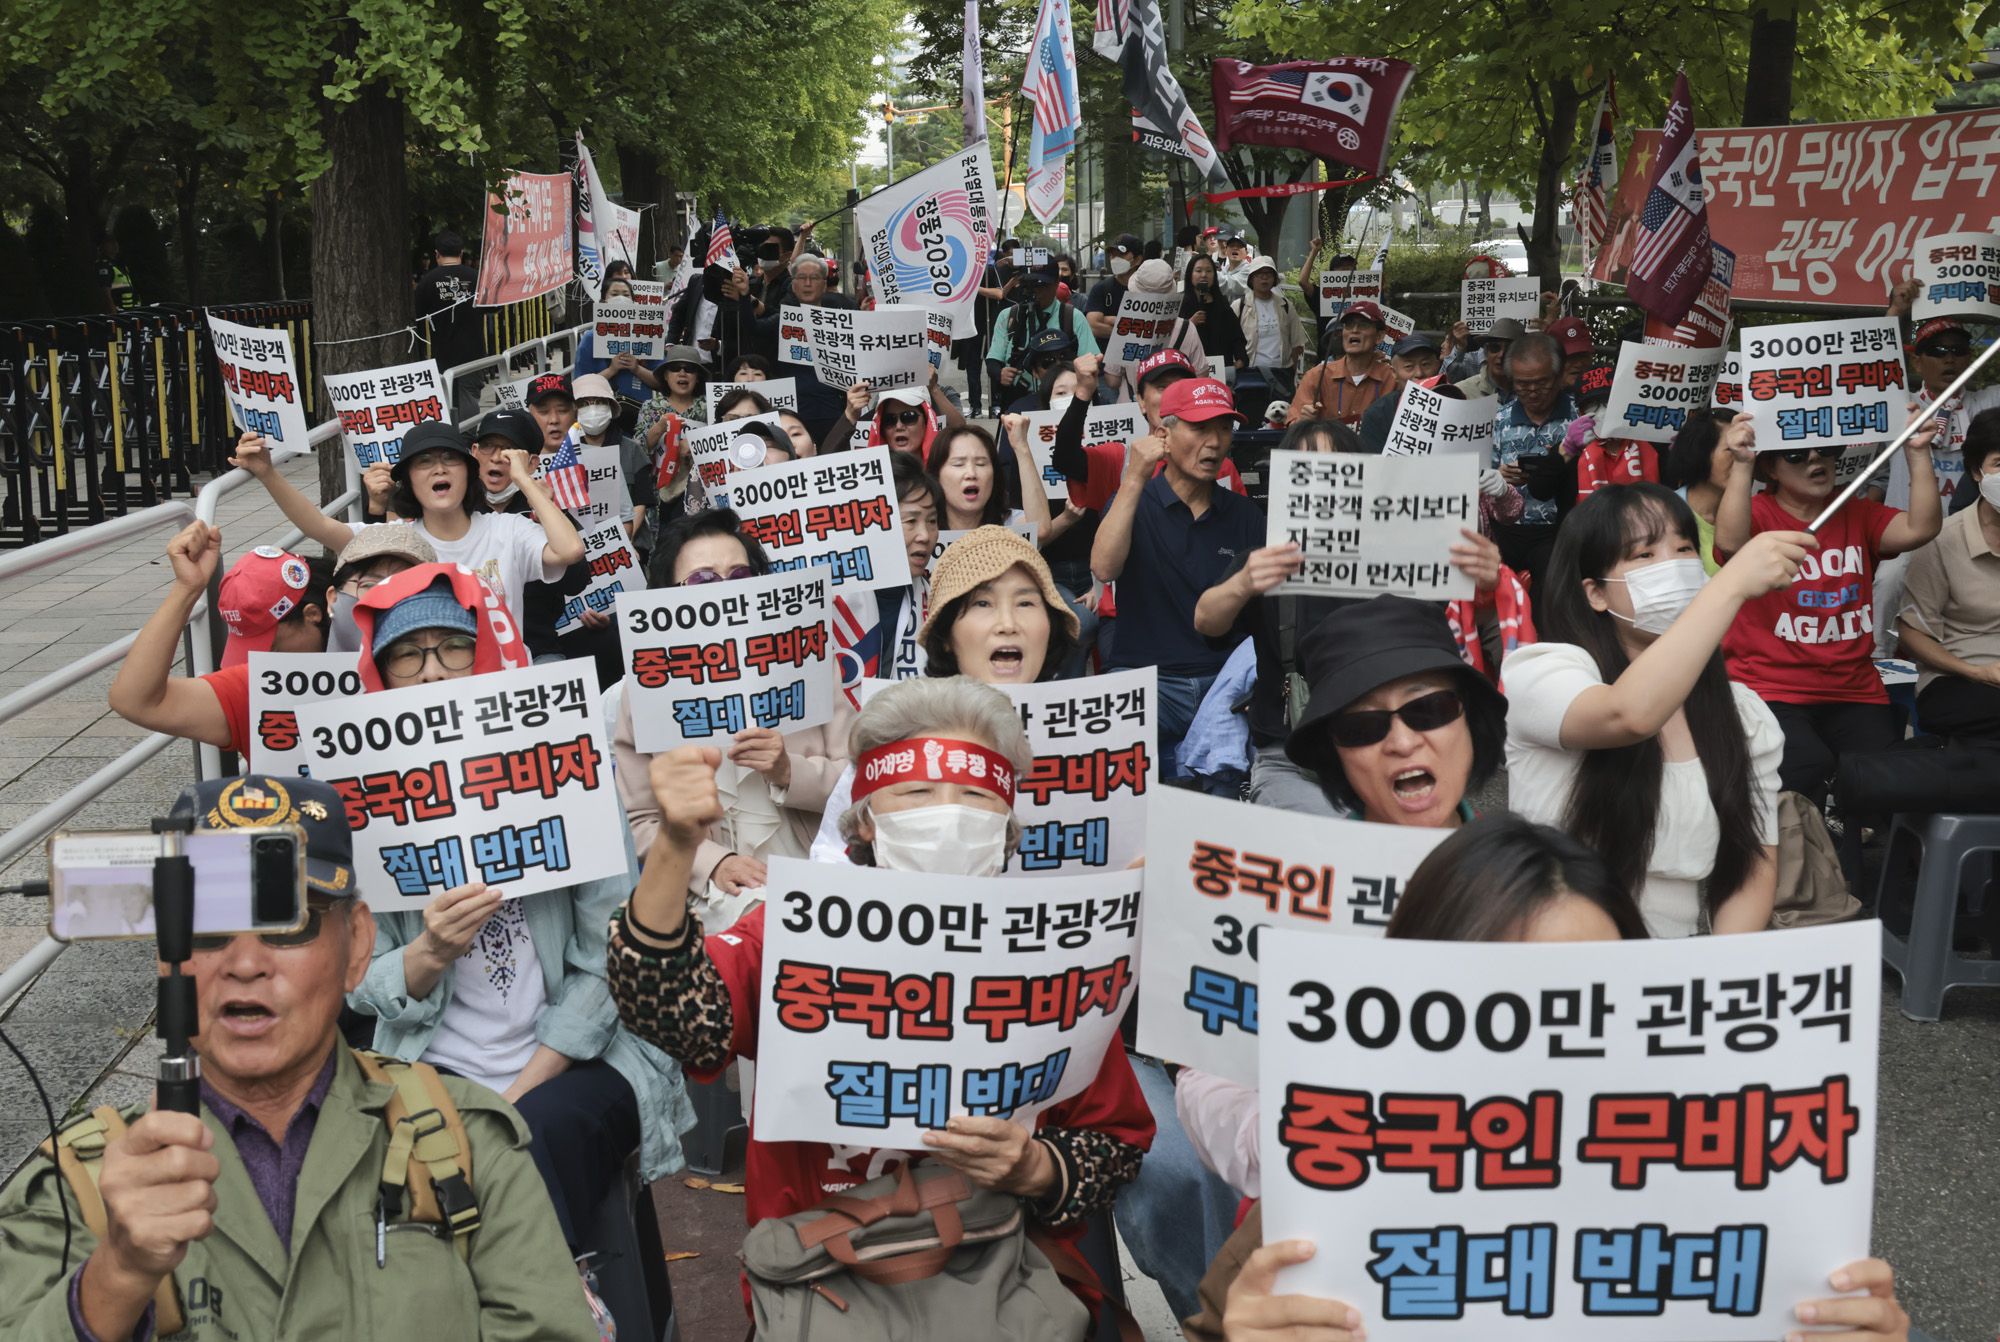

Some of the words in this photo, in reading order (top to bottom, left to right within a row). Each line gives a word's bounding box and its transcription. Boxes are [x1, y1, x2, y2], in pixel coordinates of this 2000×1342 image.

[1699, 131, 1788, 207] 중국인
[1787, 122, 1912, 208] 무비자
[916, 197, 952, 297] 장풍2030
[1765, 217, 1859, 297] 관광
[1928, 244, 1978, 265] 중국인
[632, 284, 651, 293] 000만
[1357, 274, 1380, 284] 관광객
[1467, 280, 1496, 292] 중국인
[1927, 281, 1988, 305] 무비자
[1123, 299, 1164, 315] 3000만
[1466, 292, 1496, 305] 관광객
[1497, 291, 1539, 304] 유치보다
[1466, 305, 1496, 317] 자국민
[596, 308, 637, 320] 3000만
[638, 309, 664, 321] 관광객
[809, 308, 853, 330] 중국인
[1116, 317, 1156, 339] 중국인
[1687, 310, 1723, 338] VISA-FREE
[595, 322, 631, 338] 중국인
[631, 323, 664, 339] 무비자
[812, 328, 856, 351] 관광객
[858, 332, 925, 352] 유치보다
[1749, 333, 1845, 359] 3000만
[1849, 327, 1898, 354] 관광객
[239, 337, 287, 363] 관광객
[606, 340, 631, 355] 절대
[631, 341, 653, 356] 반대
[817, 348, 857, 372] 자국민
[239, 366, 295, 404] 무비자
[329, 379, 376, 402] 3000만
[379, 369, 435, 396] 관광객
[536, 376, 564, 384] STOP
[1581, 366, 1613, 381] STOP
[1588, 374, 1606, 383] THE
[1633, 360, 1686, 383] 중국인
[1749, 364, 1832, 401] 중국인
[1836, 358, 1905, 395] 무비자
[497, 385, 519, 400] 중국인
[535, 384, 569, 393] STEAL
[1192, 386, 1206, 399] STOP
[1206, 384, 1217, 394] THE
[1406, 386, 1443, 417] 중국인
[245, 408, 284, 442] 반대
[376, 395, 443, 433] 무비자
[1088, 417, 1135, 439] 관광객
[1399, 408, 1438, 438] 관광객
[1440, 419, 1495, 443] 유치보다
[1622, 403, 1687, 432] 무비자
[1776, 406, 1833, 441] 절대
[1837, 401, 1889, 436] 반대
[354, 441, 382, 469] 절대
[691, 433, 730, 457] 3000만
[1391, 430, 1433, 456] 자국민
[1289, 460, 1364, 490] 중국인
[1933, 457, 1967, 473] REA
[733, 472, 808, 508] 3000만
[813, 459, 885, 494] 관광객
[806, 494, 894, 543] 무비자
[1286, 492, 1363, 521] 관광객
[1370, 493, 1470, 521] 유치보다
[1286, 527, 1361, 554] 자국민
[1366, 562, 1450, 587] 먼저다!
[1791, 545, 1865, 584] OON
[629, 594, 749, 634] 3000만
[756, 579, 826, 622] 관광객
[1797, 583, 1860, 609] GREAT
[1773, 603, 1874, 645] AGAIN
[632, 639, 741, 688] 중국인
[745, 620, 829, 676] 무비자
[260, 671, 362, 696] 3000
[312, 702, 465, 760] 3000만
[474, 678, 590, 737] 관광객
[672, 693, 746, 739] 절대
[749, 679, 805, 730] 반대
[1042, 687, 1146, 740] 관광객
[865, 749, 915, 781] 이재명
[945, 749, 987, 778] 투쟁
[1016, 741, 1151, 806] 무비자
[334, 759, 457, 832] 중국인
[460, 733, 602, 811] 무비자
[379, 834, 468, 897] 절대
[470, 815, 571, 885] 반대
[1020, 817, 1110, 872] 반대
[1189, 840, 1335, 921] 중국인
[781, 890, 989, 954] 3000만
[1000, 890, 1141, 955] 관광객
[771, 958, 955, 1042] 중국인
[963, 954, 1133, 1043] 무비자
[1286, 980, 1615, 1058] 3000만
[1635, 963, 1854, 1058] 관광객
[825, 1059, 952, 1131] 절대
[962, 1046, 1073, 1120] 반대
[1277, 1081, 1563, 1193] 중국인
[1577, 1074, 1860, 1192] 무비자
[1366, 1221, 1559, 1321] 절대
[1572, 1222, 1770, 1318] 반대
